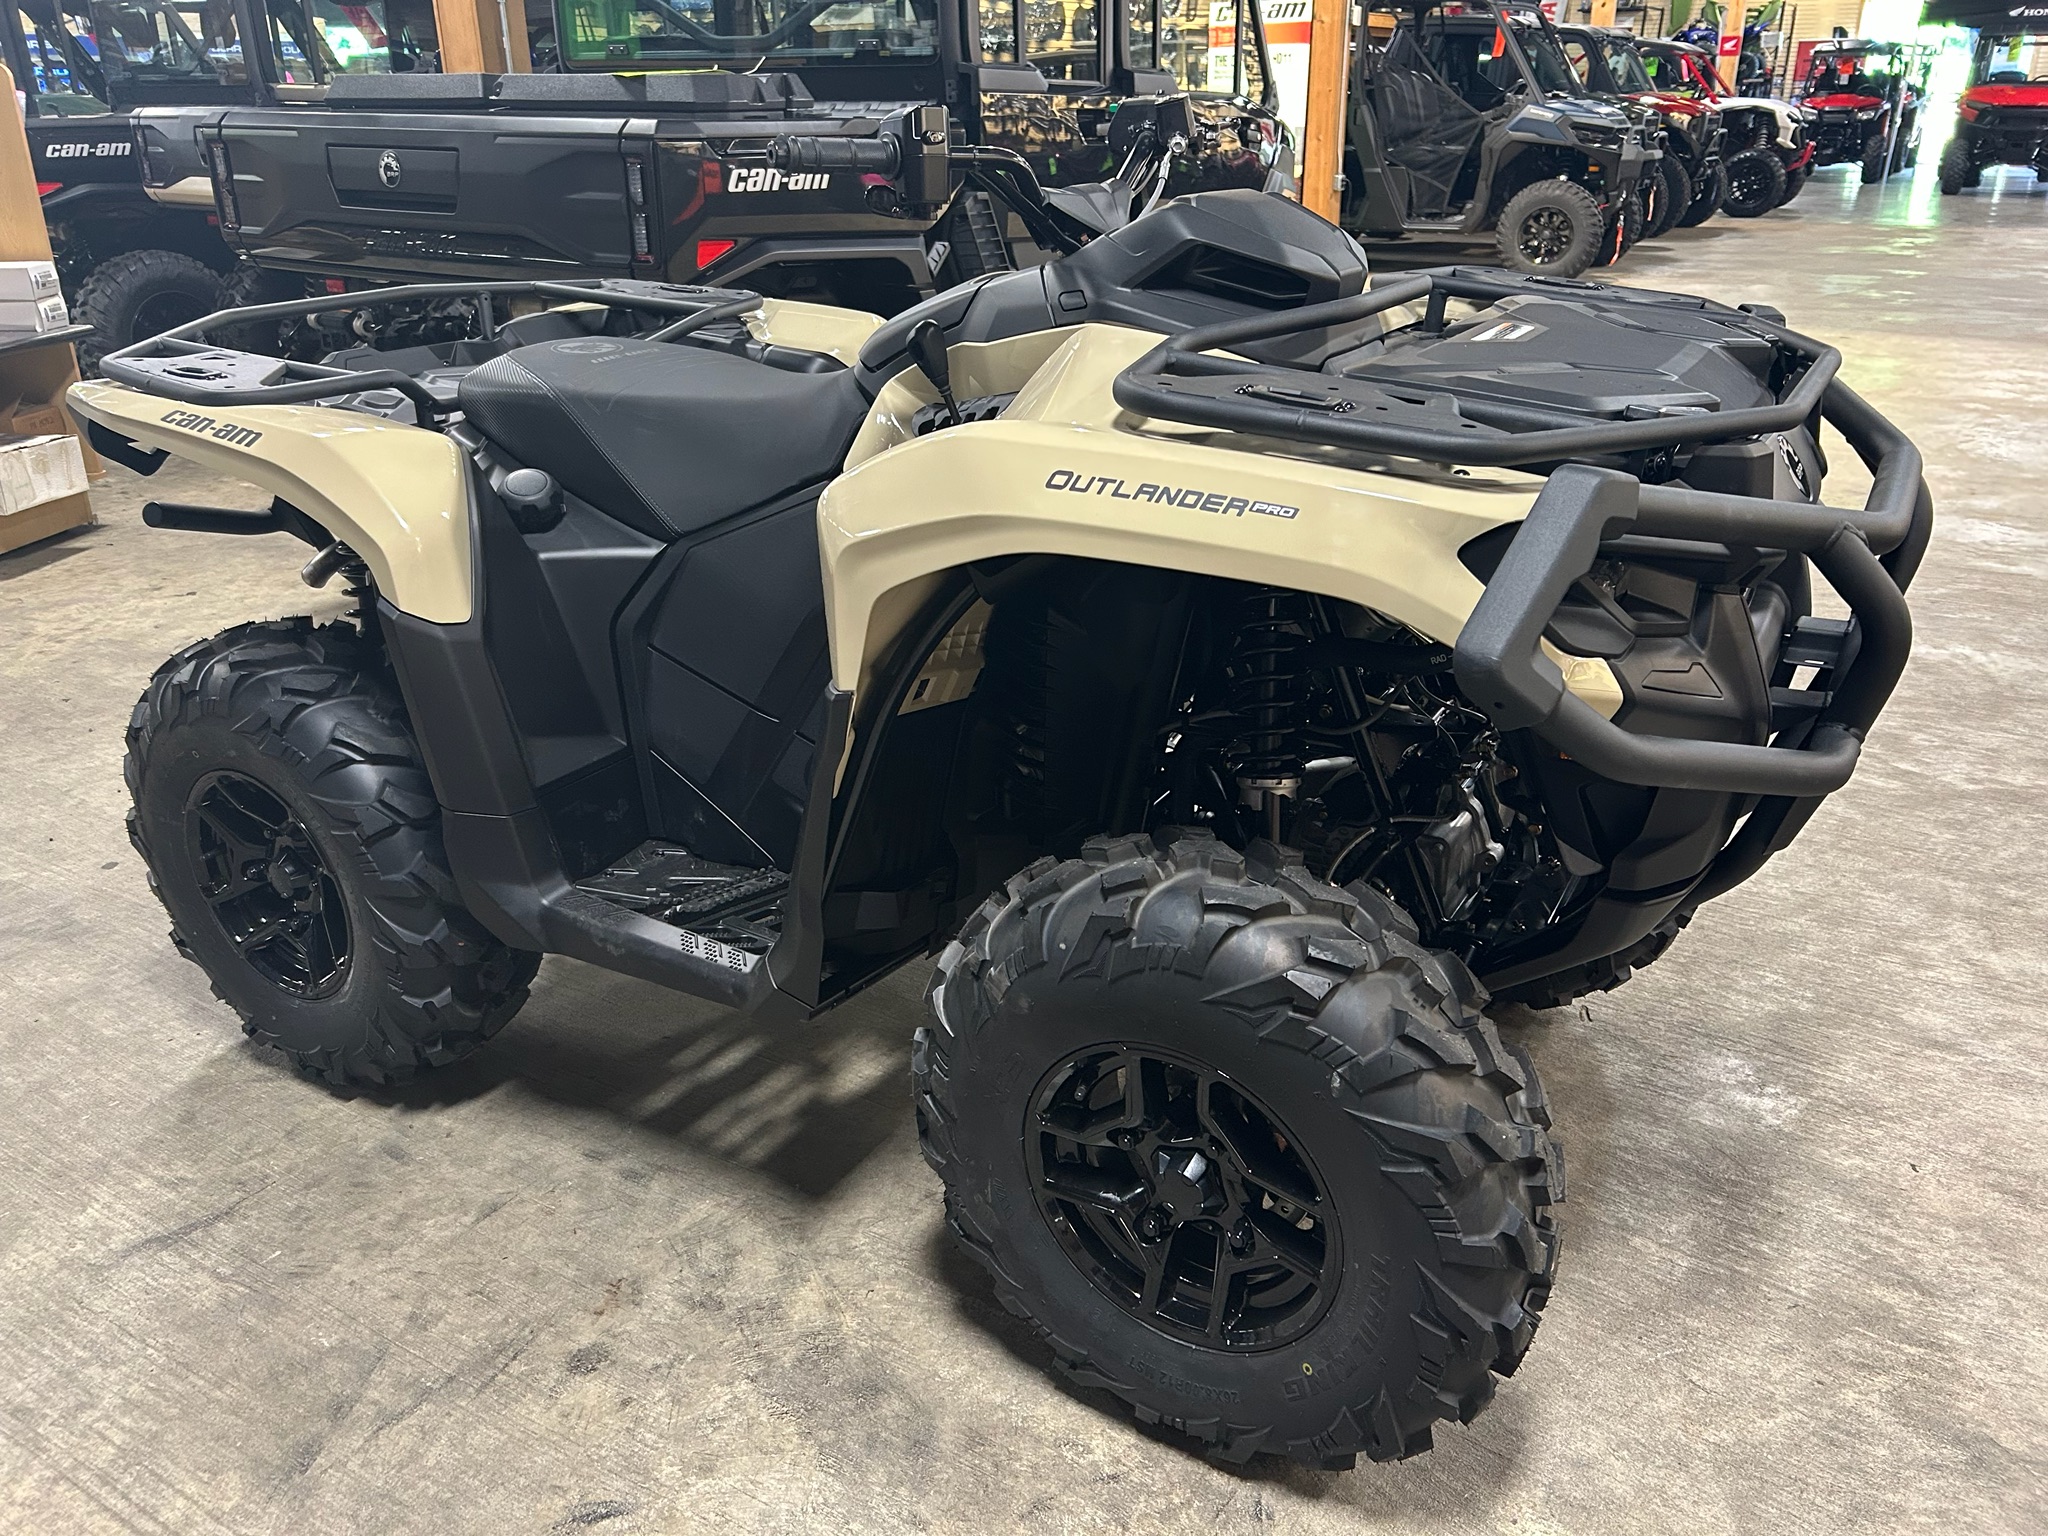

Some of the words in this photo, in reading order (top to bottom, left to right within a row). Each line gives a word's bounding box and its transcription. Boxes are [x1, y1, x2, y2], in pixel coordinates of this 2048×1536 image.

[46, 141, 131, 158] can-am
[728, 168, 830, 193] can-am
[161, 409, 263, 448] can-am
[1045, 469, 1249, 517] OUTLANDER
[1251, 501, 1298, 519] PRO
